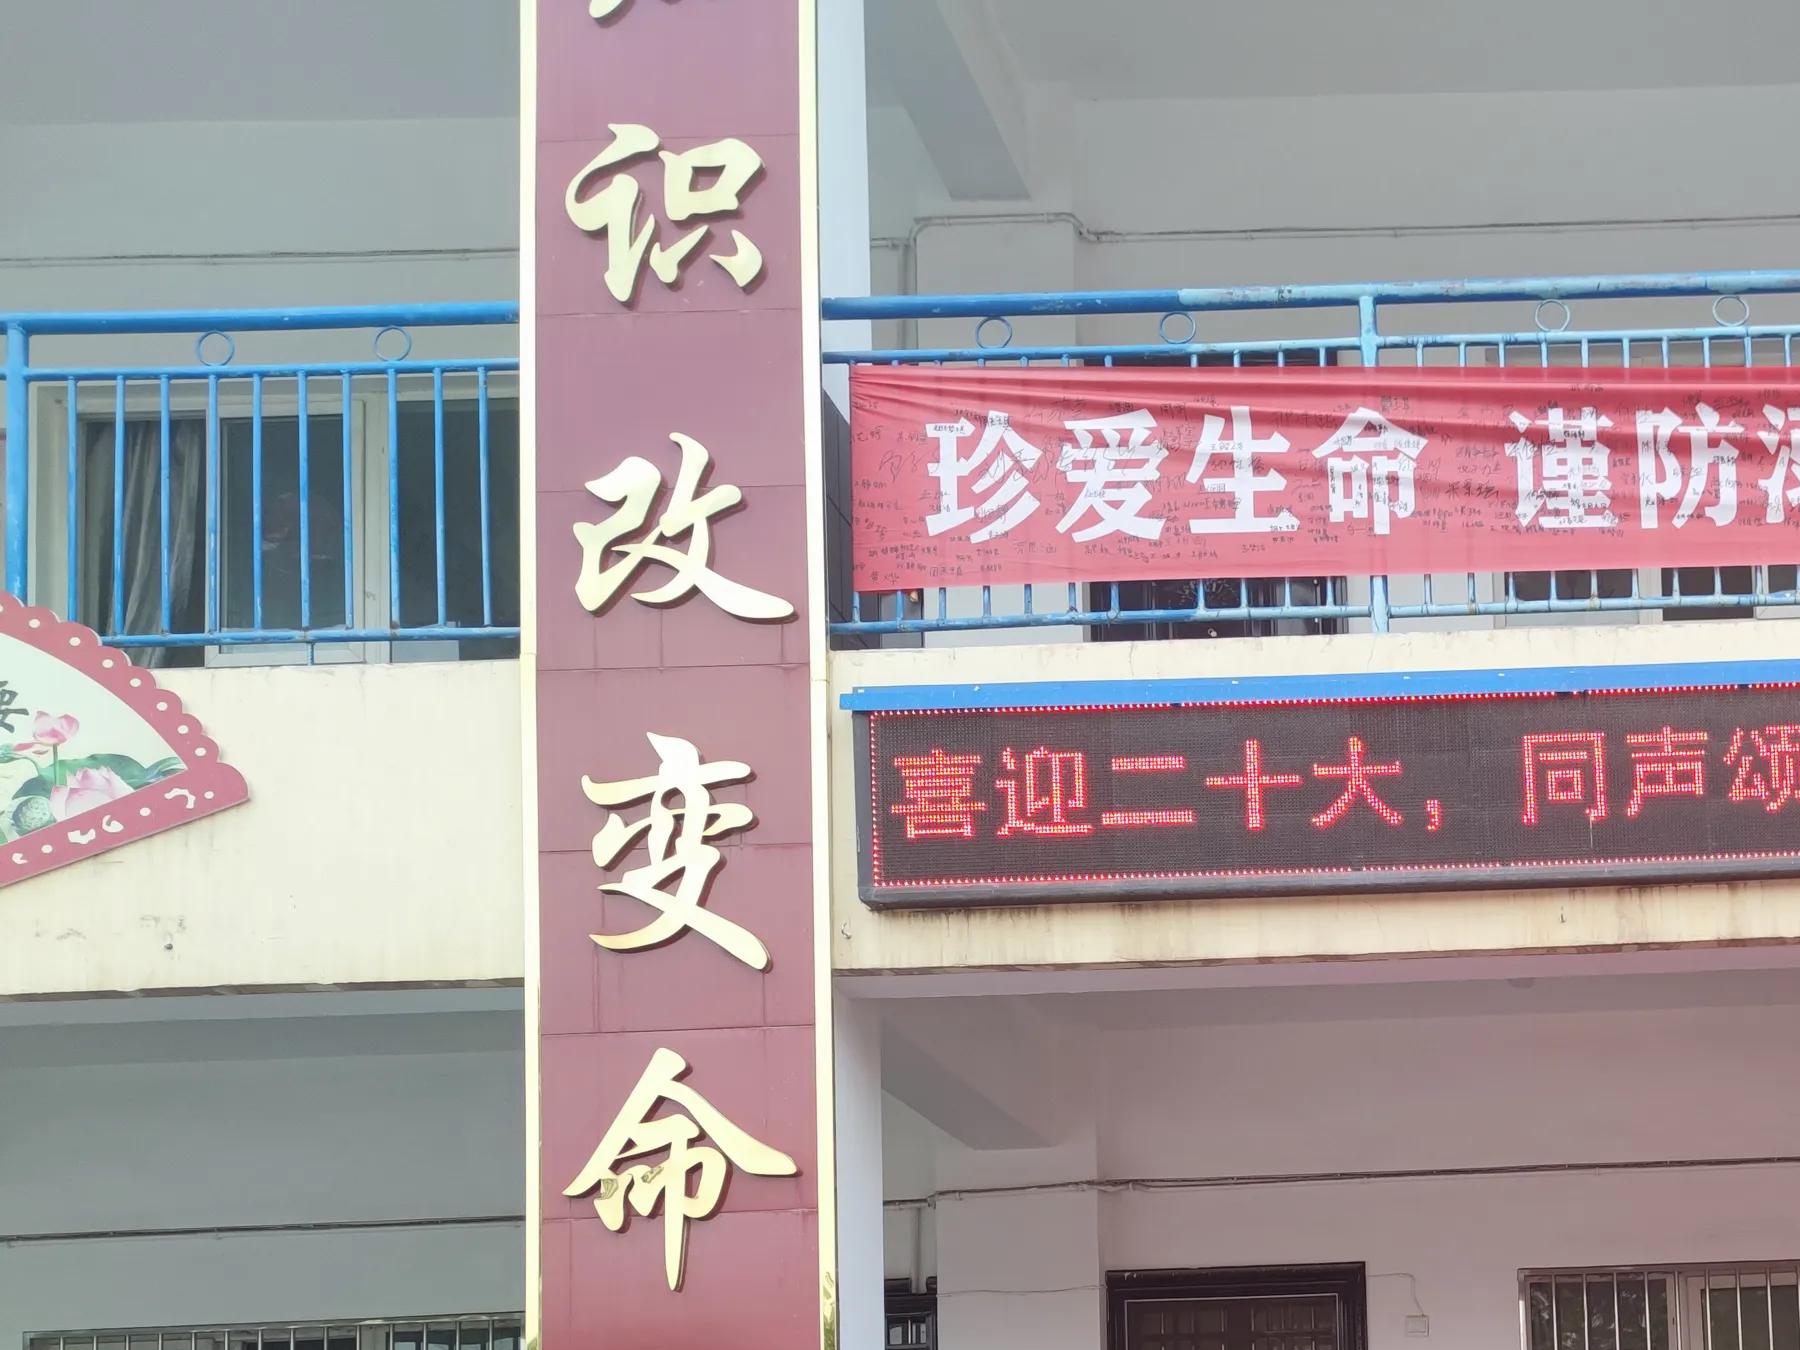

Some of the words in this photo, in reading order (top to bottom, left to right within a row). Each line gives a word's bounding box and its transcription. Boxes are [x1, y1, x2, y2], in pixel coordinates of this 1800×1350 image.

[562, 0, 799, 1291] 识改变命
[926, 404, 1429, 545] 珍爱生命
